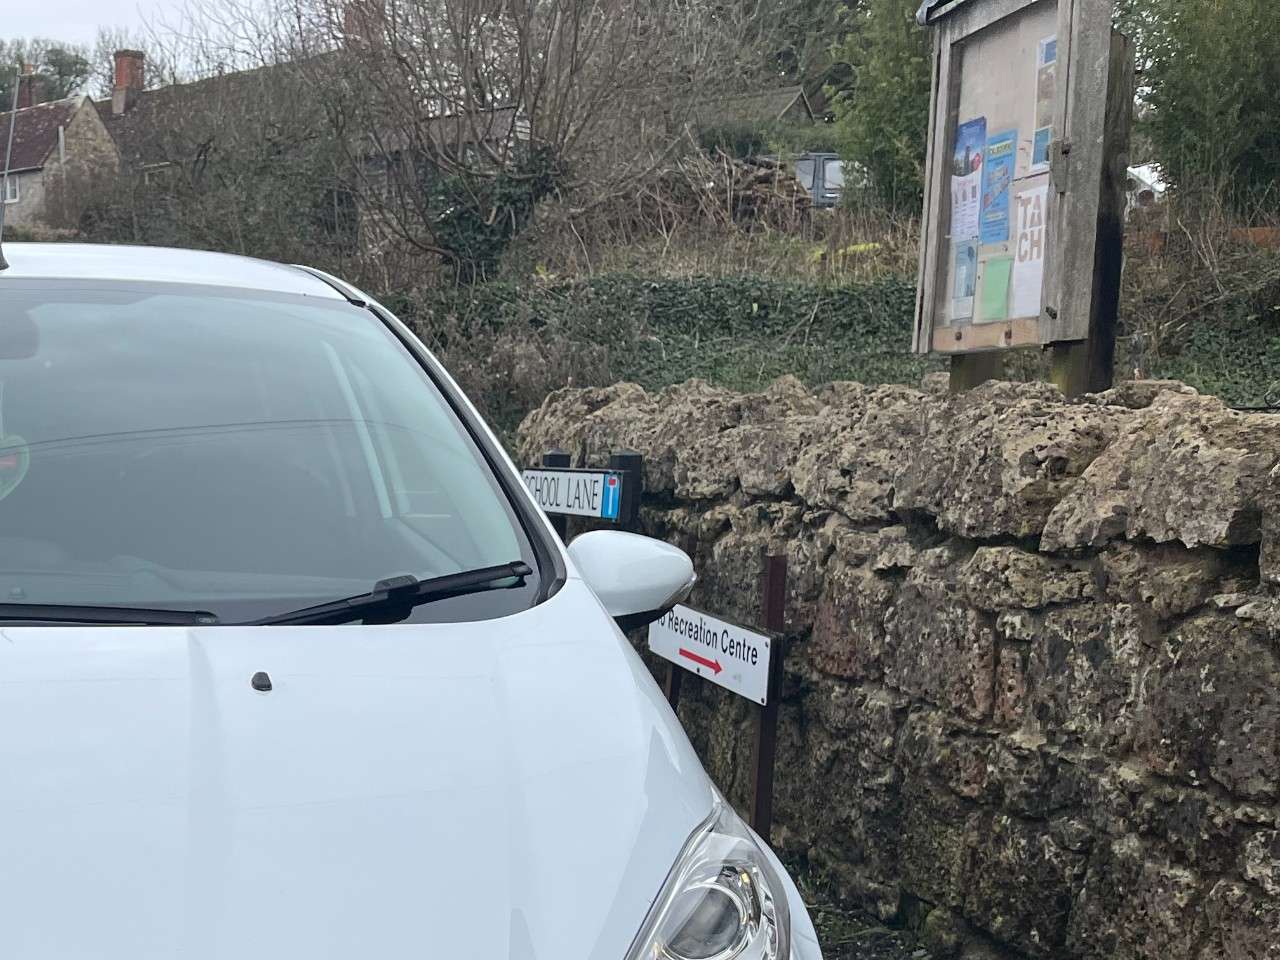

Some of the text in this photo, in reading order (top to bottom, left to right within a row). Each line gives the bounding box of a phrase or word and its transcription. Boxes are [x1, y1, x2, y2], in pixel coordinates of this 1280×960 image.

[566, 477, 599, 511] LANE
[668, 608, 718, 649] Recreation
[720, 629, 758, 665] Centre
